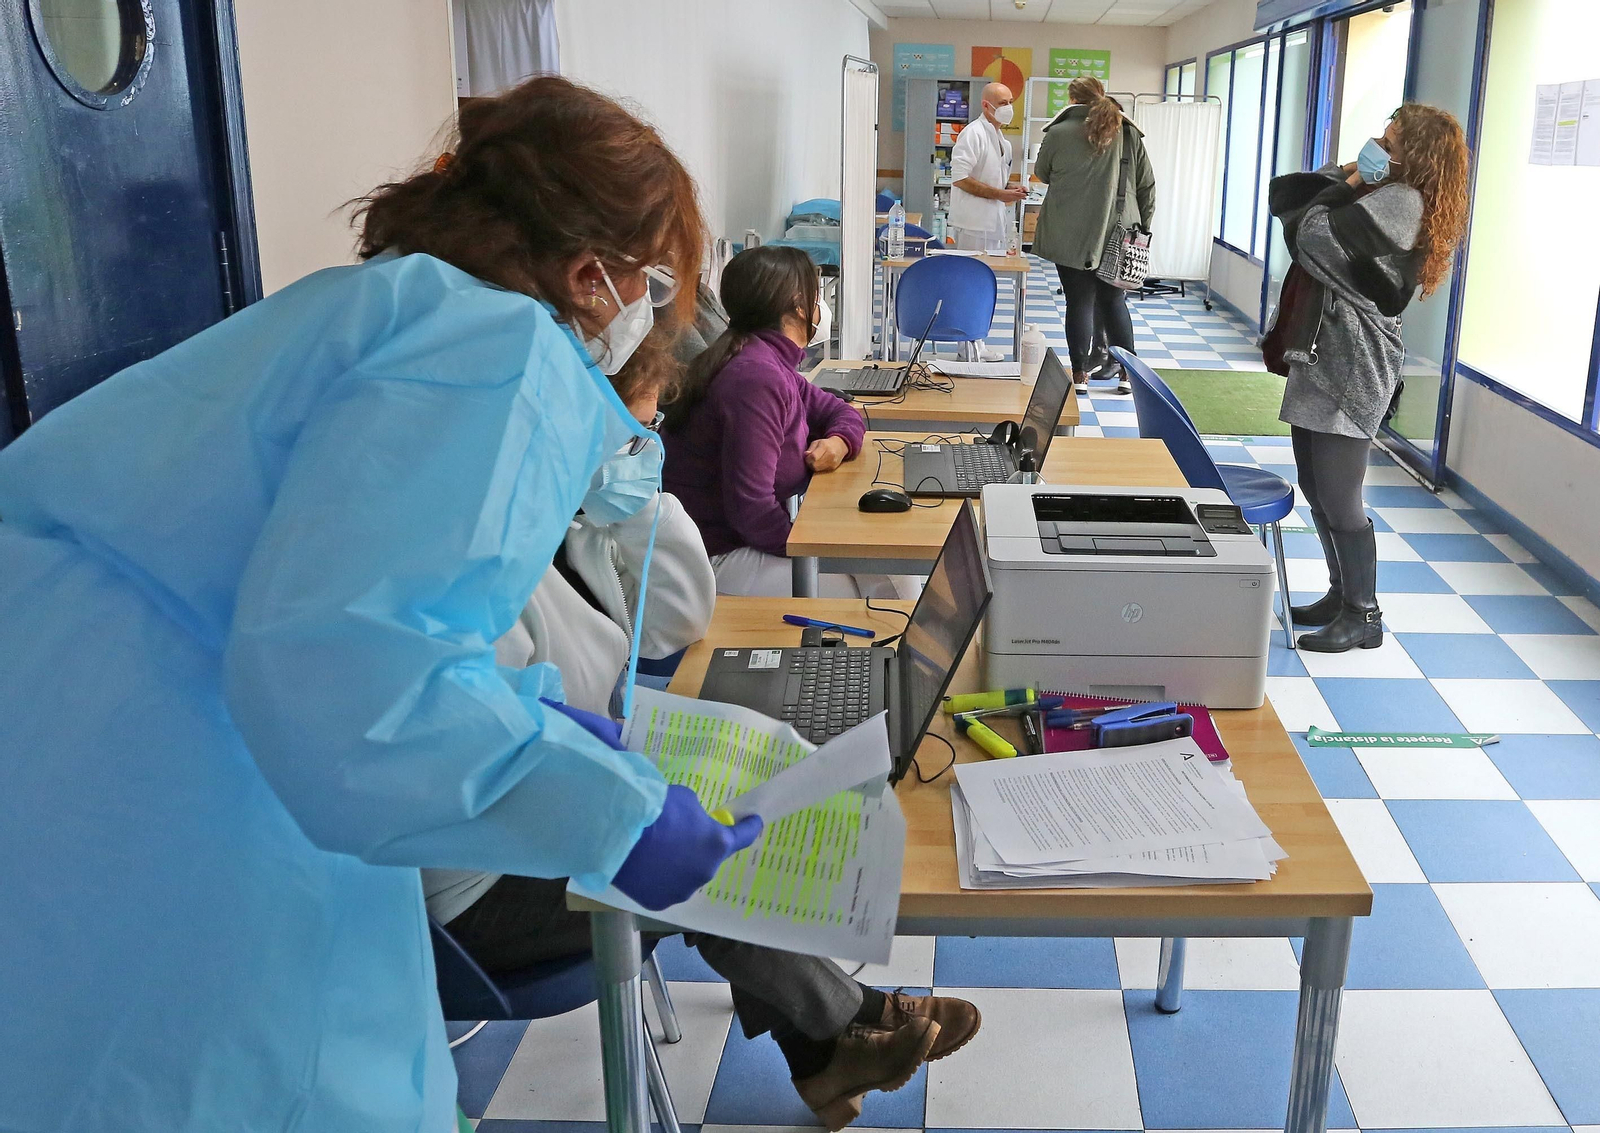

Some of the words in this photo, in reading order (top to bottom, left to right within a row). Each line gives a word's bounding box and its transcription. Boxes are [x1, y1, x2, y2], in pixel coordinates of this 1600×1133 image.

[1313, 735, 1378, 743] distancia
[1379, 736, 1395, 744] la
[1396, 735, 1453, 744] Respete
